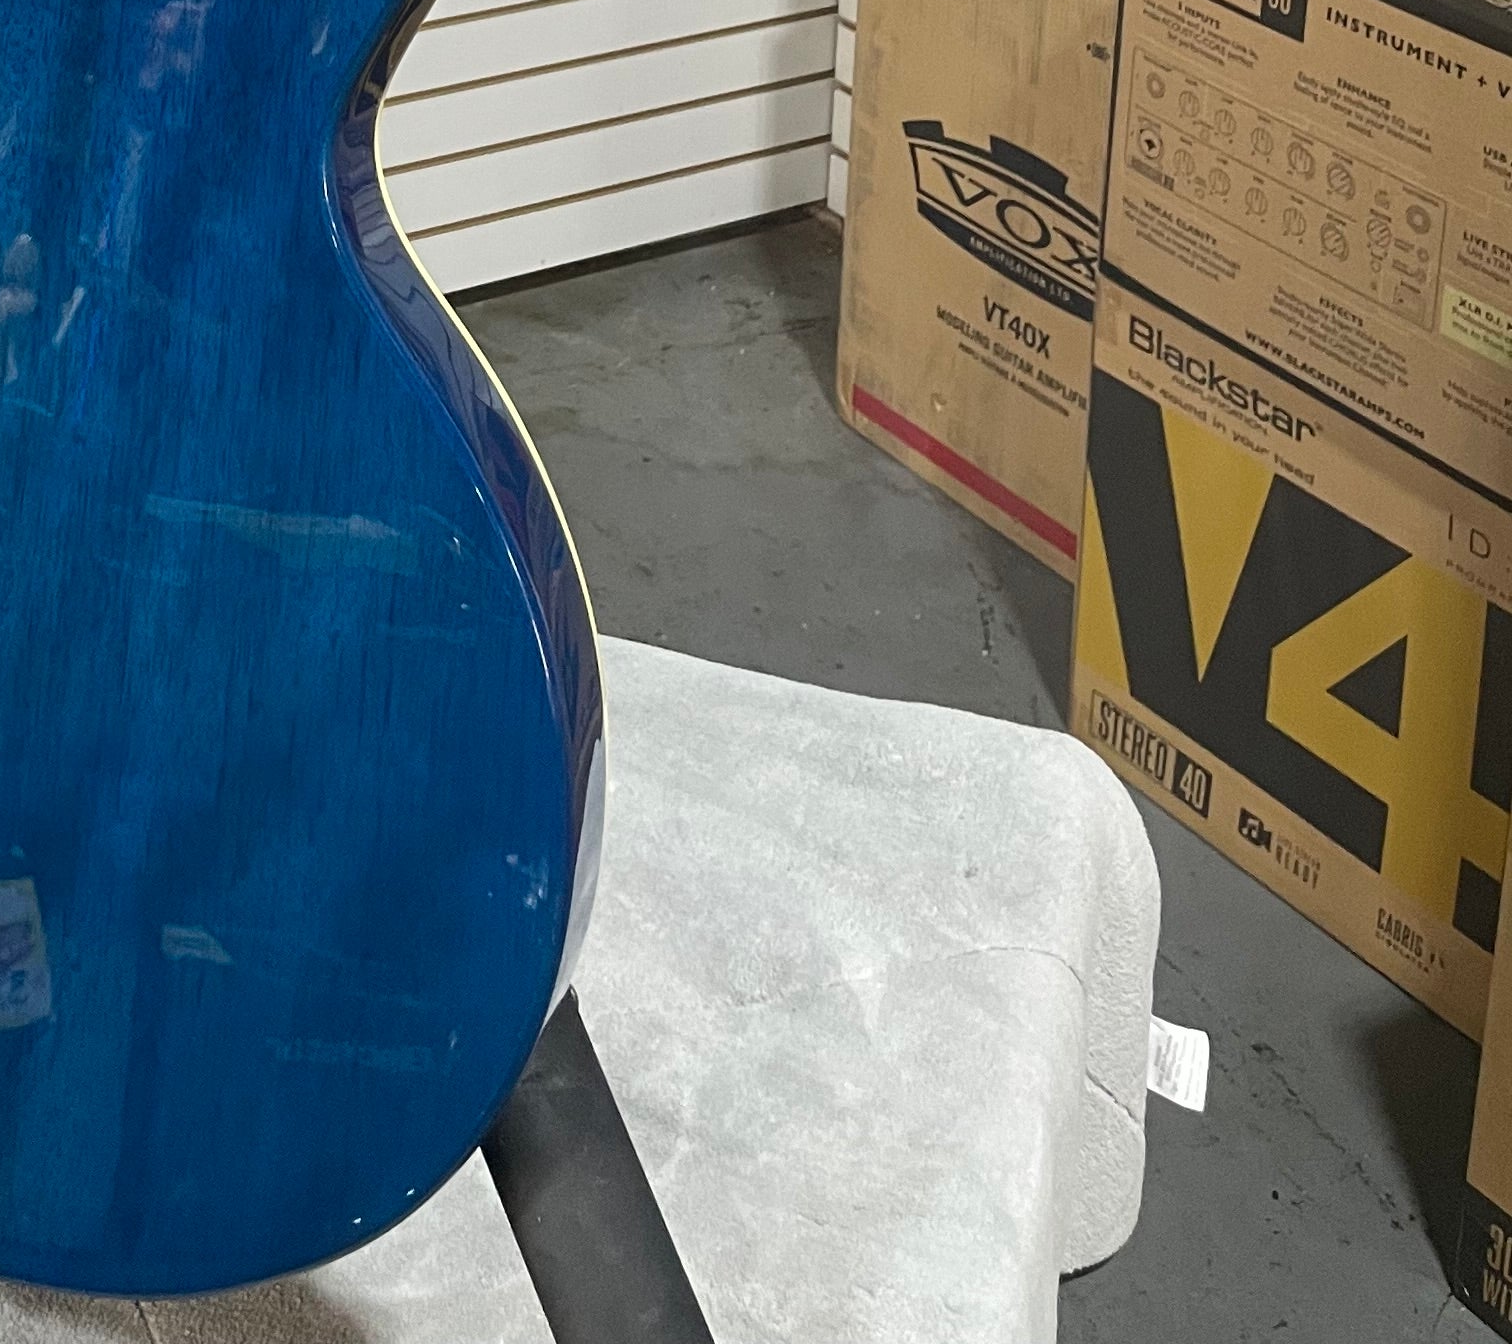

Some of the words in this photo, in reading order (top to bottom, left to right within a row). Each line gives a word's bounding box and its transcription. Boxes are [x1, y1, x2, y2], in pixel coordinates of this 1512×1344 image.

[1326, 6, 1468, 80] INSTRUMENT
[1477, 74, 1487, 88] +
[931, 157, 1098, 282] VOX
[983, 294, 1051, 360] VT40X
[1128, 314, 1317, 442] Blackstar
[1245, 327, 1426, 440] WWW.BLACKSTARAMPS.COM
[1232, 429, 1271, 455] your
[1097, 699, 1168, 782] STEREO
[1179, 762, 1207, 810] 40
